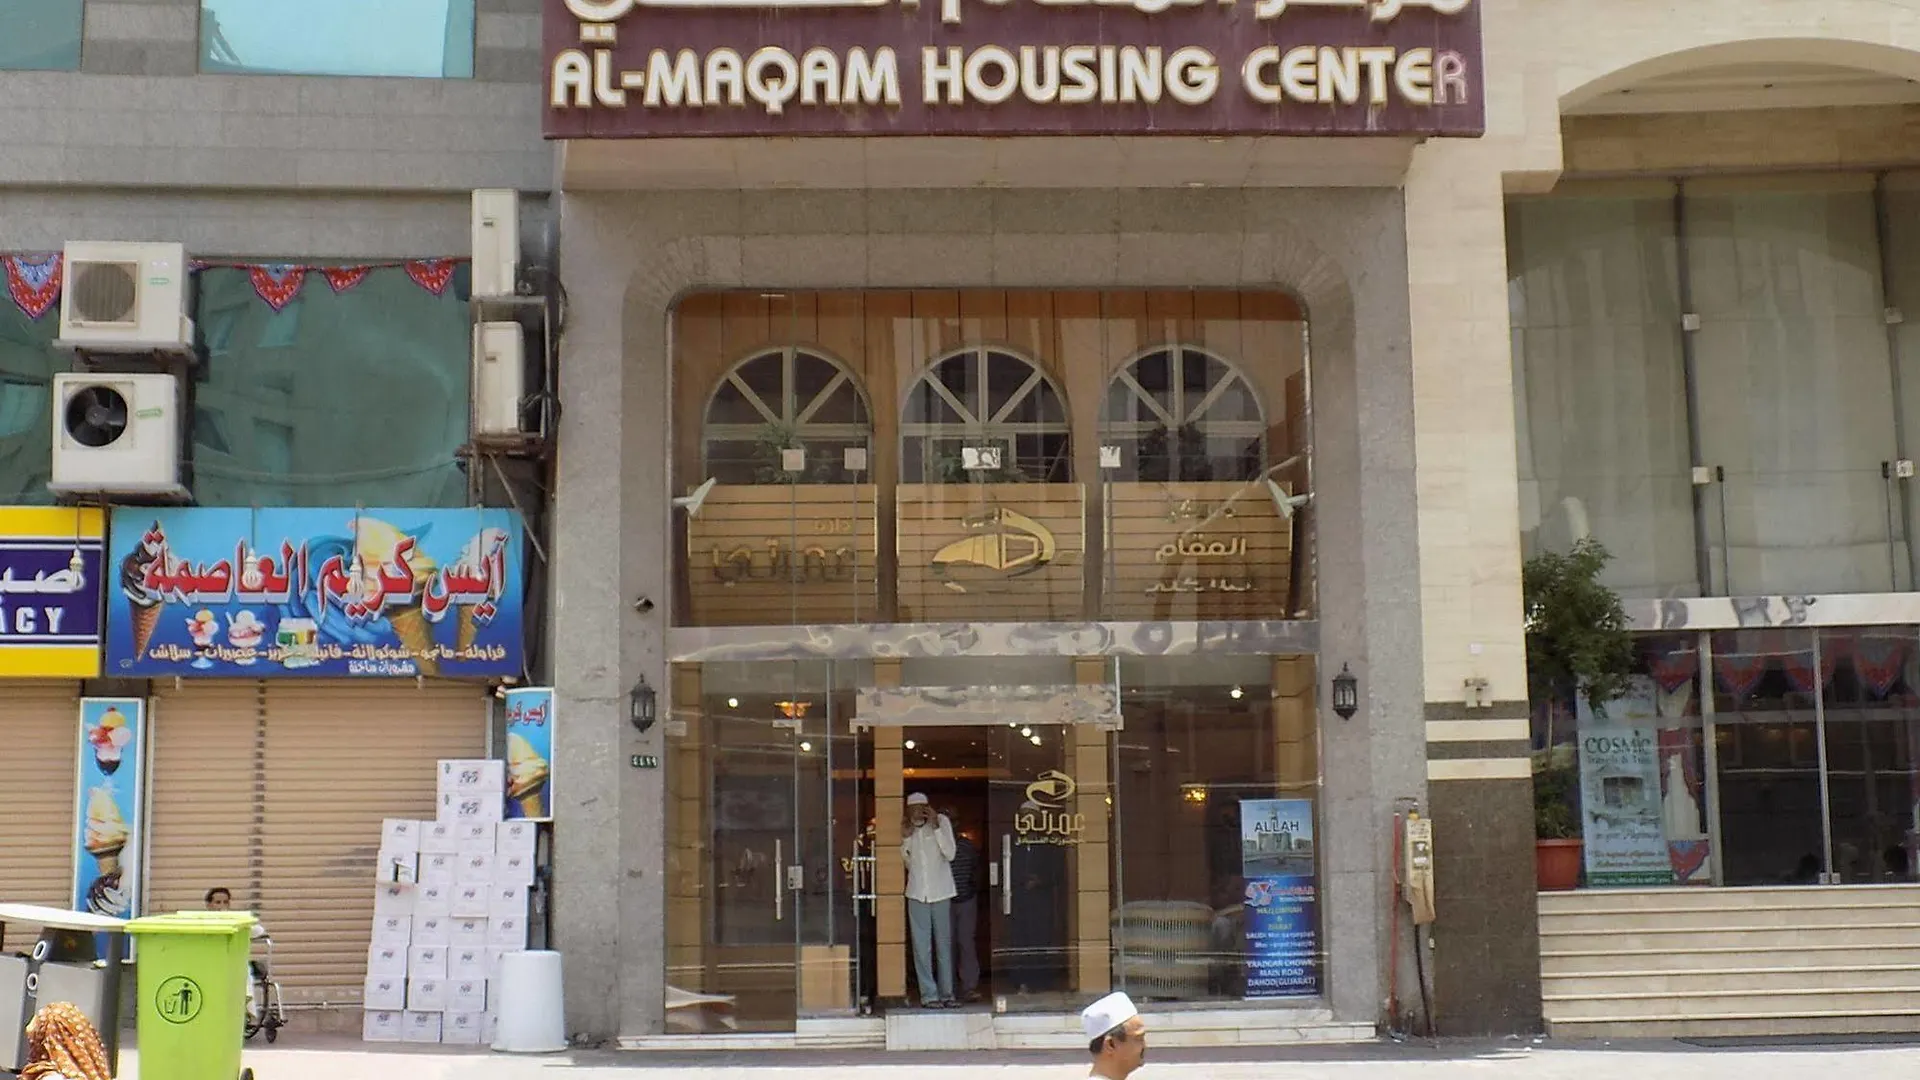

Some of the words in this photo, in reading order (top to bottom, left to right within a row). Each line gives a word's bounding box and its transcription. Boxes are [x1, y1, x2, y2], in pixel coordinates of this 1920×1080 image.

[551, 46, 901, 114] AL-MAQAM
[921, 45, 1220, 104] HOUSING
[1241, 45, 1467, 104] CENTER
[143, 530, 308, 605] العاصمة
[316, 535, 416, 625] كريم
[421, 532, 509, 624] آيس
[1155, 534, 1247, 562] المقام
[1254, 820, 1300, 832] ALLAH
